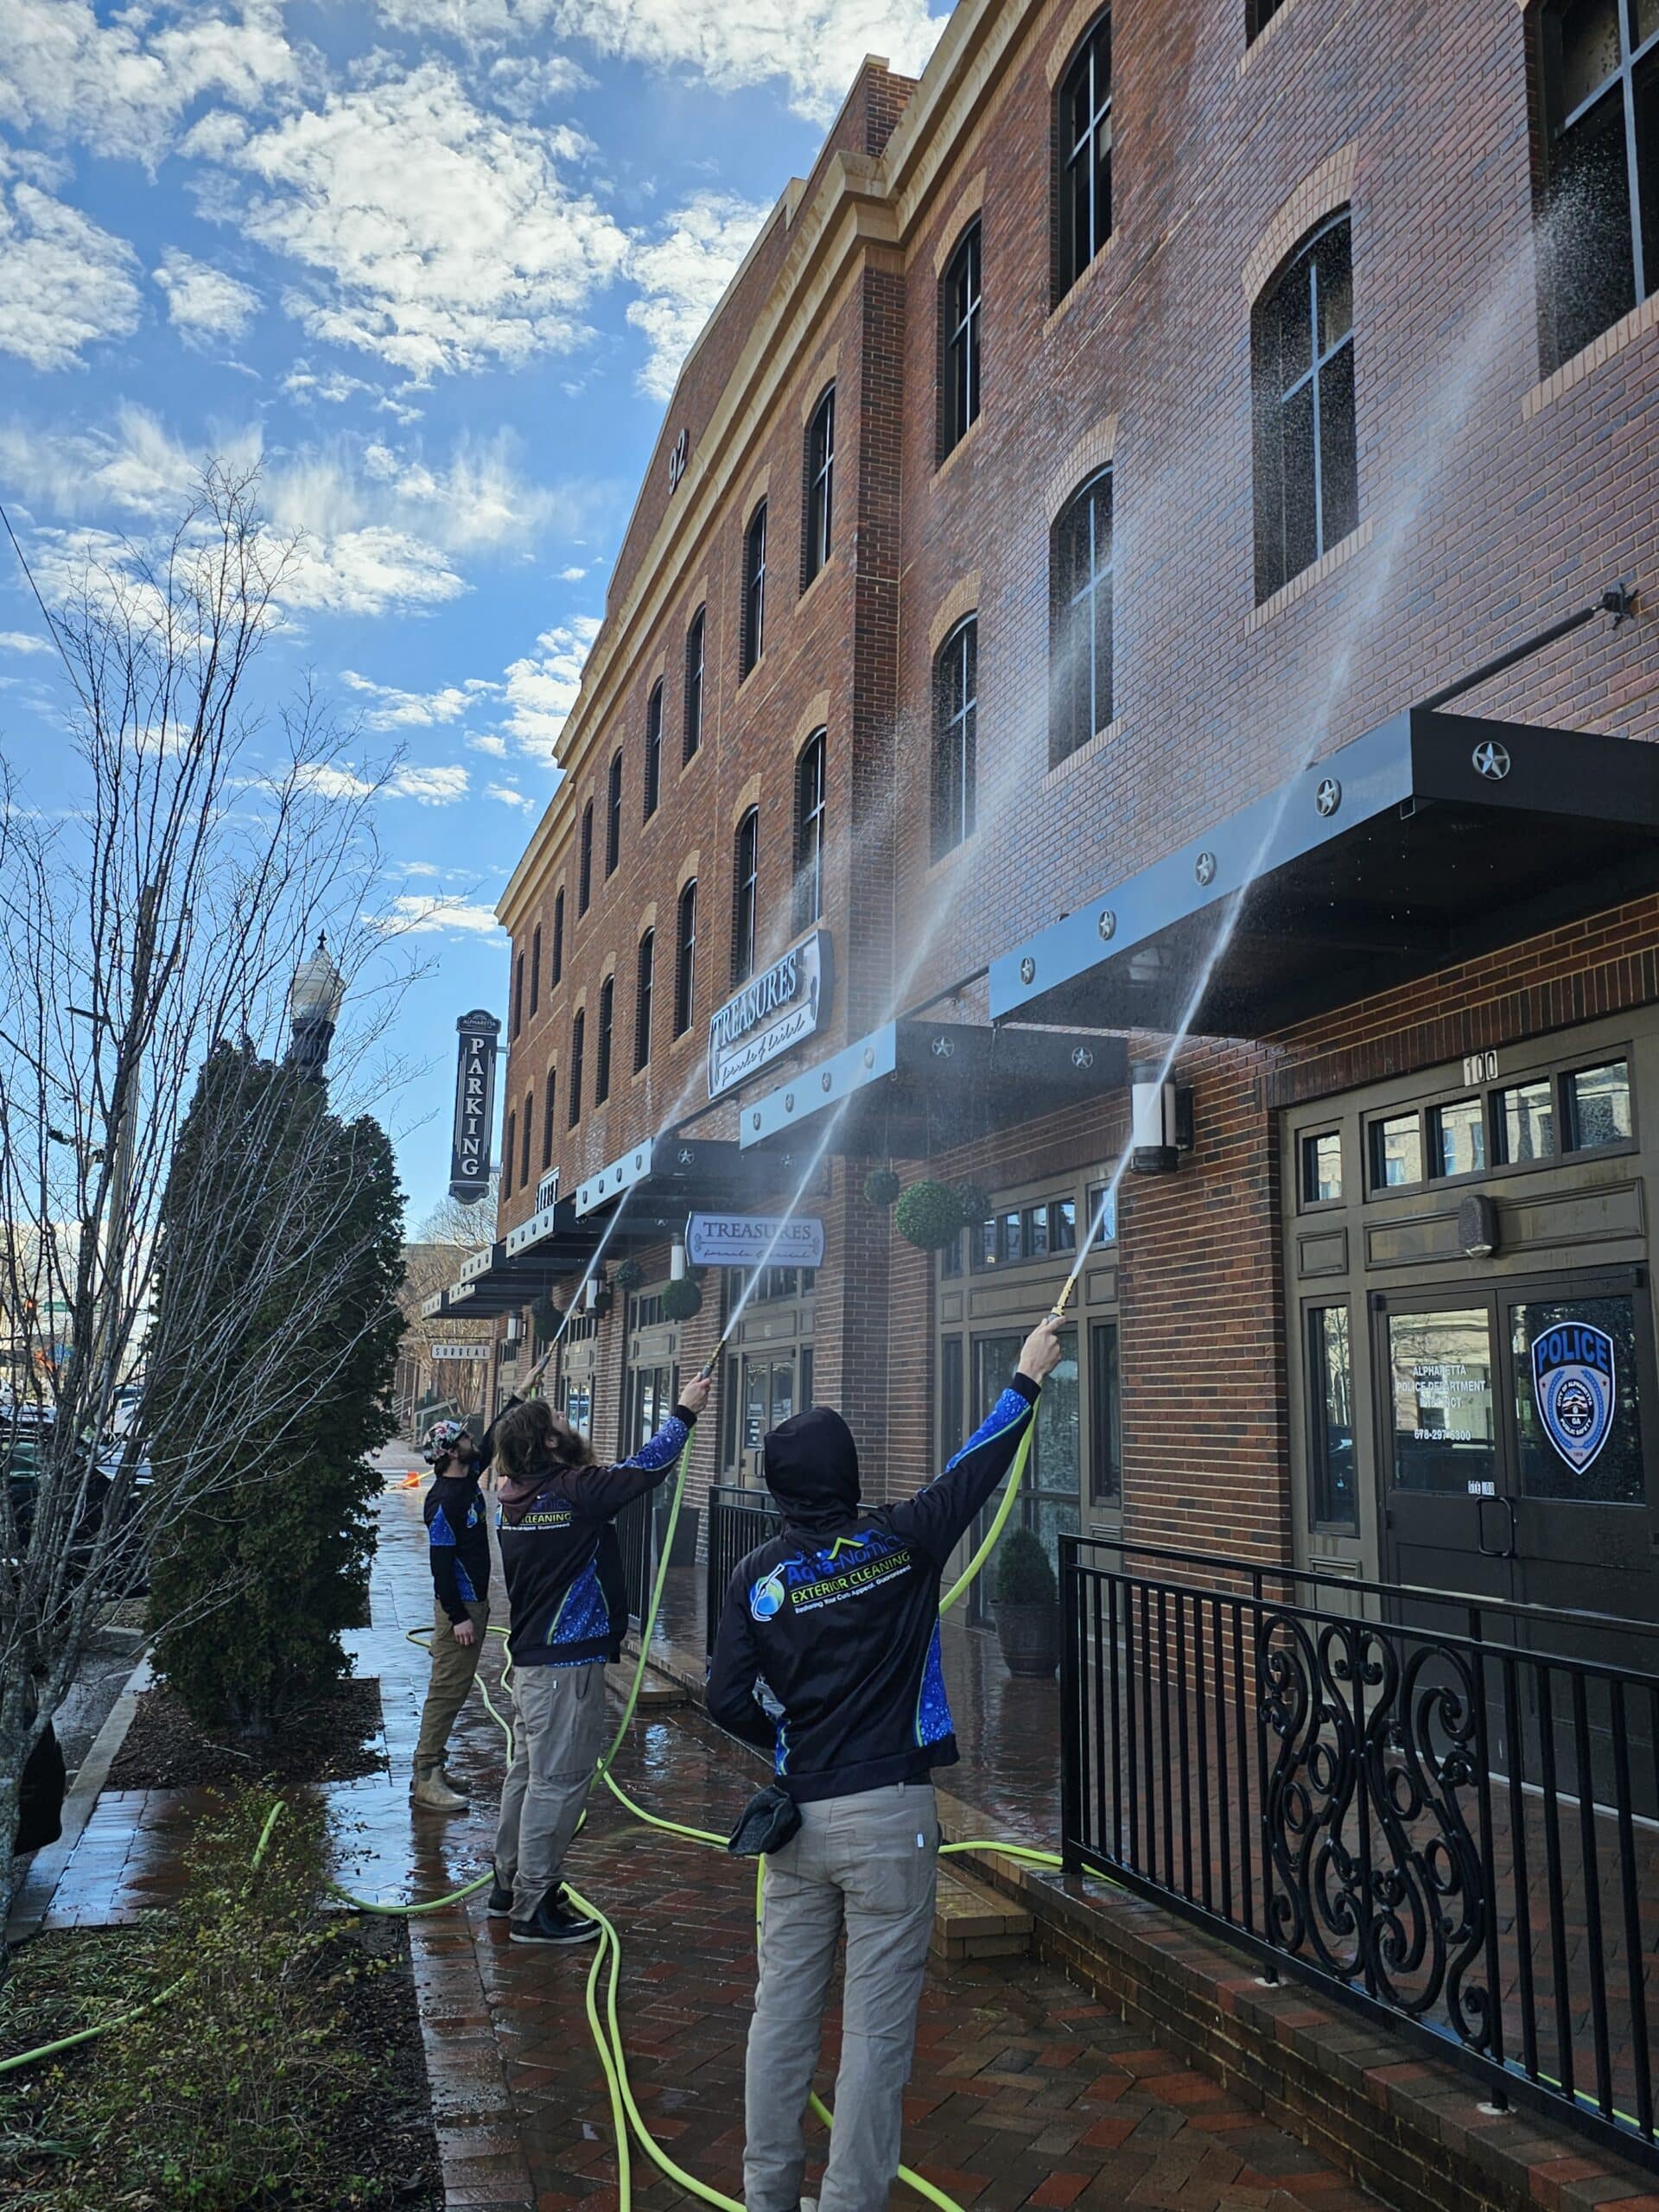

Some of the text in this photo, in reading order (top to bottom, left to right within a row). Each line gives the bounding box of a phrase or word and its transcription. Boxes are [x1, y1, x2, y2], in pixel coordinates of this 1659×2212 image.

[668, 429, 689, 496] 92
[712, 955, 798, 1051] TREASURES
[1465, 1052, 1496, 1084] 100
[461, 1038, 486, 1176] PARKING
[702, 1221, 811, 1240] TREASURES
[435, 1347, 486, 1357] SURREAL
[1537, 1331, 1609, 1375] POLICE
[1396, 1381, 1485, 1392] POLICE DEPARTMENT
[524, 1512, 571, 1523] CLEANING
[791, 1551, 912, 1604] EXTERIOR CLEANING
[823, 1596, 837, 1605] Your
[836, 1592, 851, 1601] Curb
